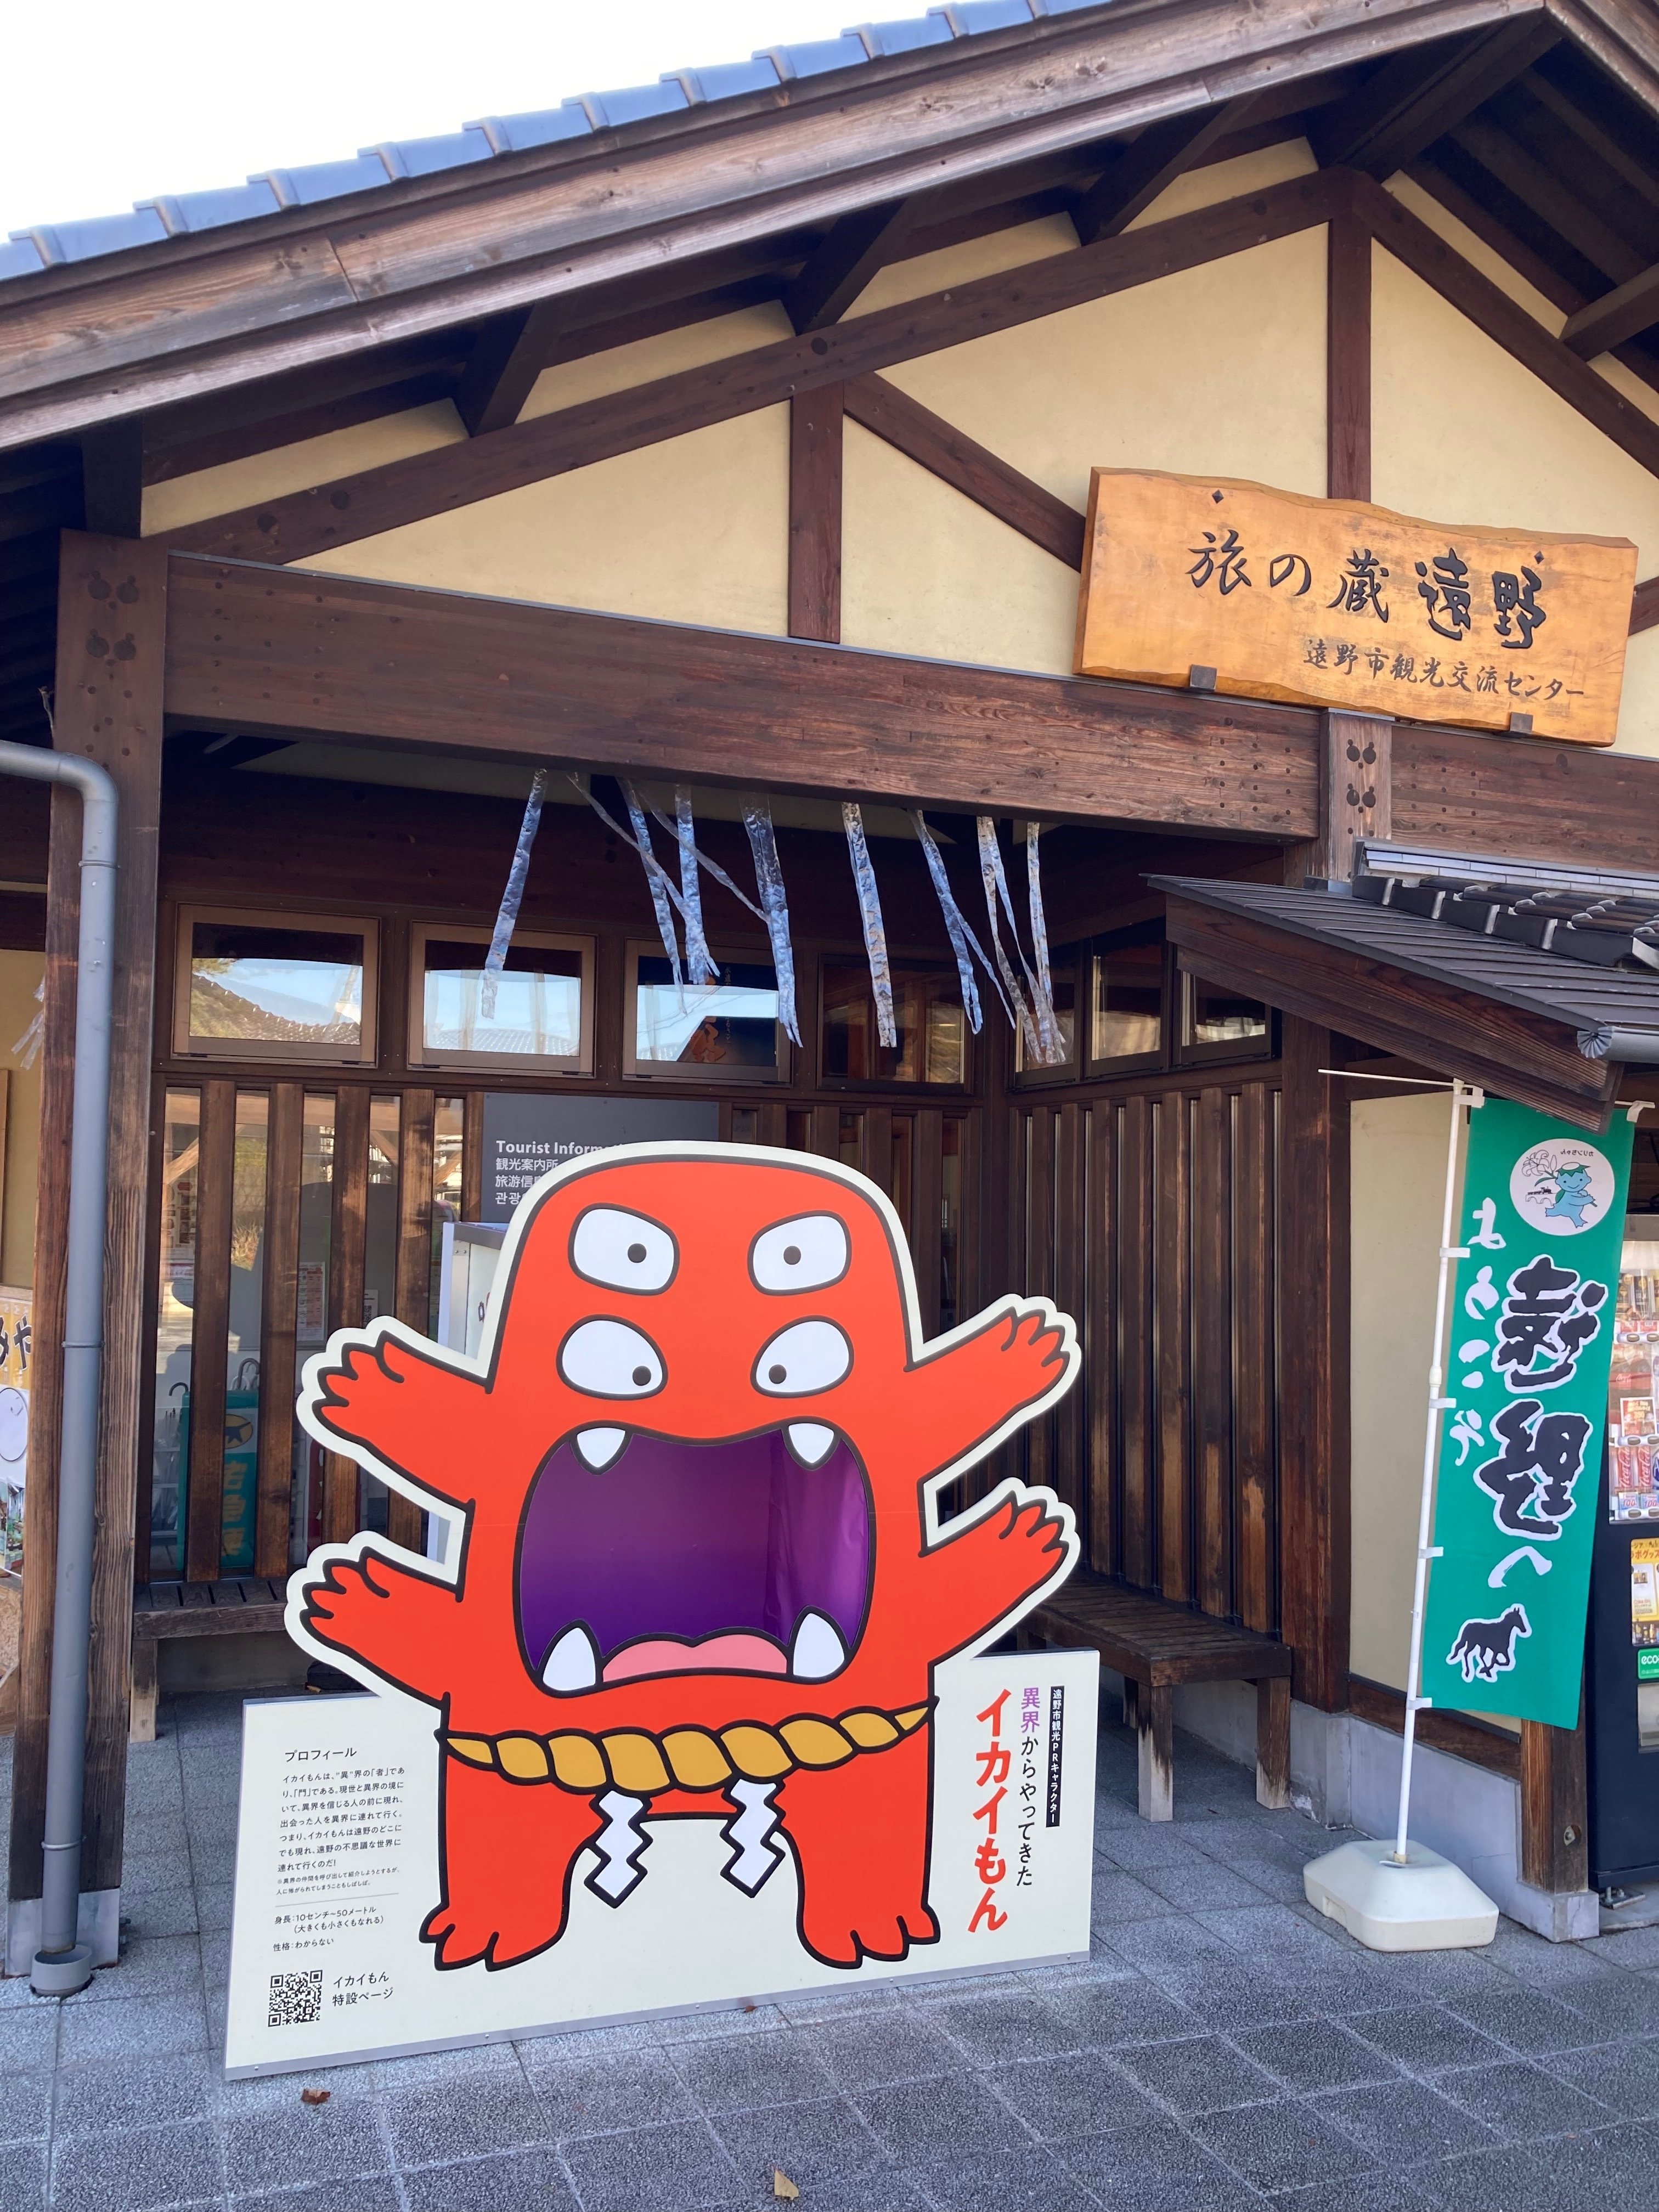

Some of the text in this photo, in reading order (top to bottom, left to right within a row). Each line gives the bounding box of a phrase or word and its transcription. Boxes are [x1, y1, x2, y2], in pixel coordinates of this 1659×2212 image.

[1302, 639, 1585, 701] 遠野市観光交流センター
[496, 1140, 550, 1154] Tourist
[495, 1157, 558, 1171] 観光案内所
[495, 1192, 525, 1205] 관광
[285, 1747, 357, 1762] プロフィール
[1049, 1688, 1062, 1824] 遠野市観光PRキャラクター
[1017, 1687, 1041, 1886] 異界からやってきた
[281, 1796, 403, 1813] いて、異界を信じる人の前に現れ、
[968, 1689, 1012, 1933] イカイもん
[280, 1810, 402, 1828] 出会った人を異界に連れて行く。
[279, 1824, 402, 1842] つまり、イカイもんは遠野のどこに
[279, 1838, 401, 1857] でも現れ、遠野の不思議な世界に
[333, 1971, 390, 1989] イカイもん
[332, 1987, 393, 2007] 特設ページ
